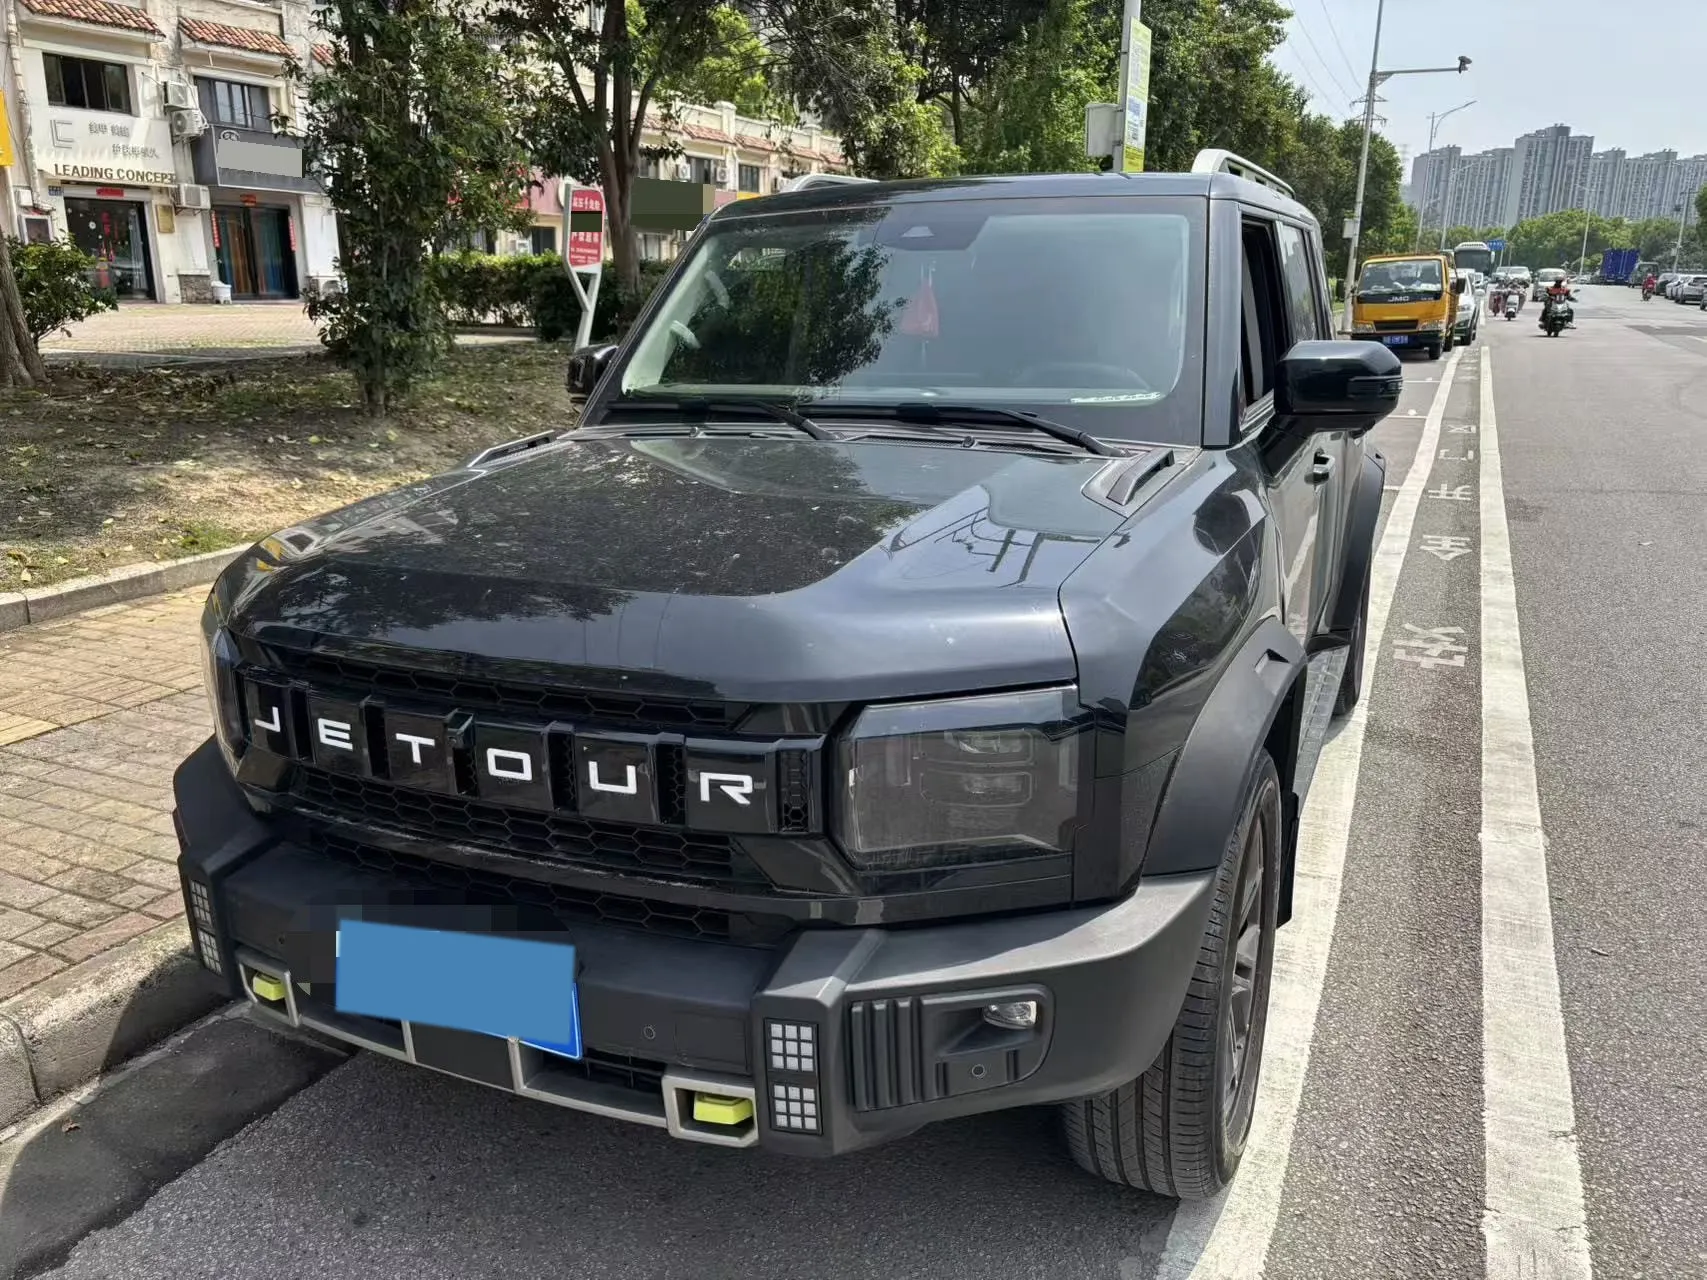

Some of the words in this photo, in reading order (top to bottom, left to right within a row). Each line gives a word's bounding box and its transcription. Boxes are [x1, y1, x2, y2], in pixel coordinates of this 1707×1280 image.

[54, 163, 113, 180] LEADING
[116, 168, 176, 184] CONCEPT
[1387, 295, 1410, 303] JMC
[254, 706, 754, 805] JETOUR
